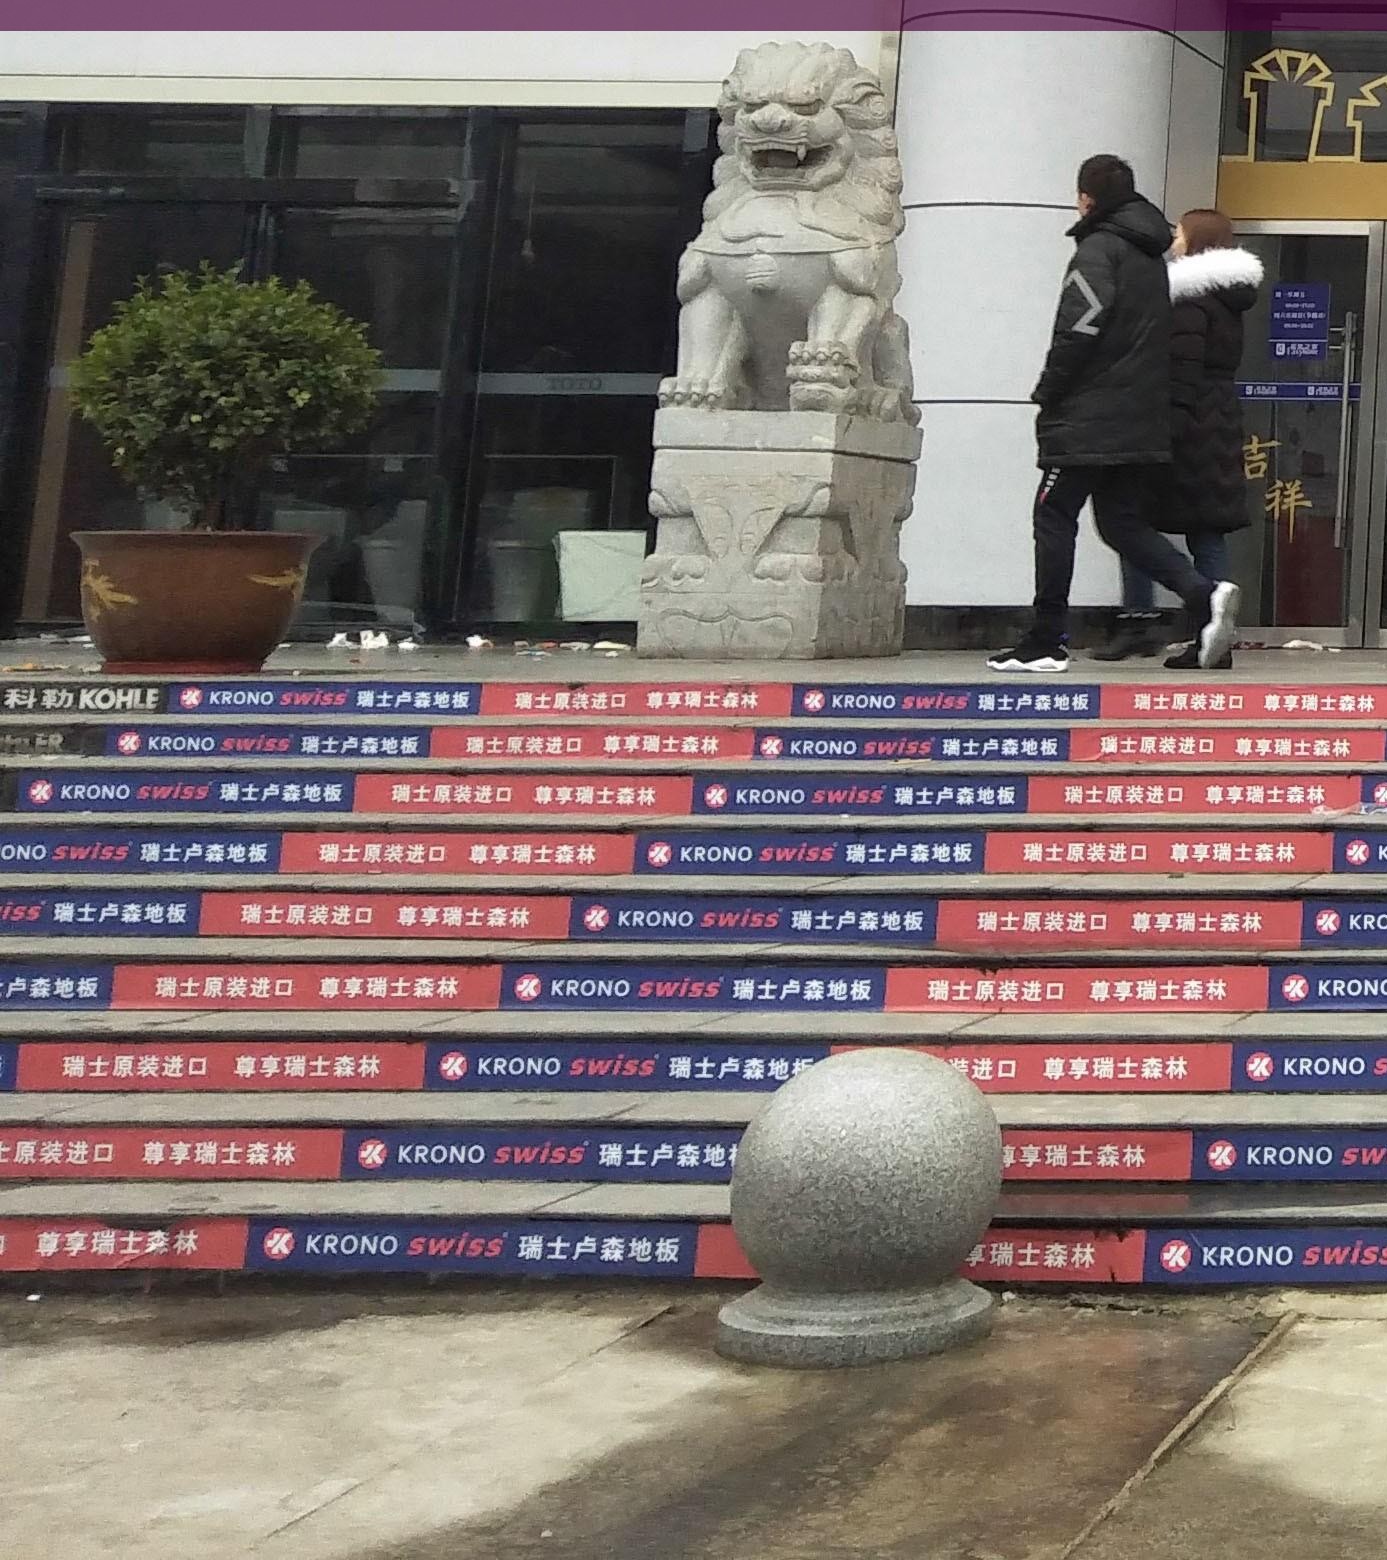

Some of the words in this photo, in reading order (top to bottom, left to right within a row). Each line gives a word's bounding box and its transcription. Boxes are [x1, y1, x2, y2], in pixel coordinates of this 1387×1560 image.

[210, 691, 274, 705] KRONO
[281, 692, 346, 705] swiss
[356, 690, 469, 708] 瑞士卢森地板
[515, 692, 625, 710] 瑞士原装进口
[647, 691, 758, 709] 尊享瑞士森林
[790, 741, 857, 754] KRONO
[864, 740, 931, 755] swiss
[942, 738, 1057, 756] 瑞士卢森地板
[1101, 736, 1214, 754] 瑞士原装进口
[1236, 738, 1350, 757] 尊享瑞士森林
[61, 785, 130, 799] KRONO
[138, 786, 208, 799] swiss
[220, 783, 342, 802] 瑞士卢森地板
[392, 784, 512, 803] 瑞士原装进口
[535, 786, 655, 806] 尊享瑞士森林
[681, 846, 752, 862] KRONO
[760, 846, 833, 861] swiss
[846, 843, 972, 863] 瑞士卢森地板
[1024, 843, 1146, 862] 瑞士原装进口
[1170, 843, 1295, 862] 尊享瑞士森林
[54, 902, 186, 924] 瑞士卢森地板
[241, 904, 372, 925] 瑞士原装进口
[397, 906, 529, 928] 尊享瑞士森林
[551, 980, 630, 996] KRONO
[640, 979, 720, 997] swiss
[733, 978, 871, 1001] 瑞士卢森地板
[928, 980, 1063, 1001] 瑞士原装进口
[1090, 979, 1226, 1002] 尊享瑞士森林
[478, 1057, 560, 1075] KRONO
[570, 1056, 655, 1076] swiss
[1044, 1057, 1187, 1080] 尊享瑞士森林
[143, 1141, 295, 1165] 尊享瑞士森林
[1248, 1147, 1332, 1165] KRONO
[306, 1234, 398, 1254] KRONO
[409, 1233, 502, 1256] swiss
[518, 1235, 679, 1262] 瑞士卢森地板
